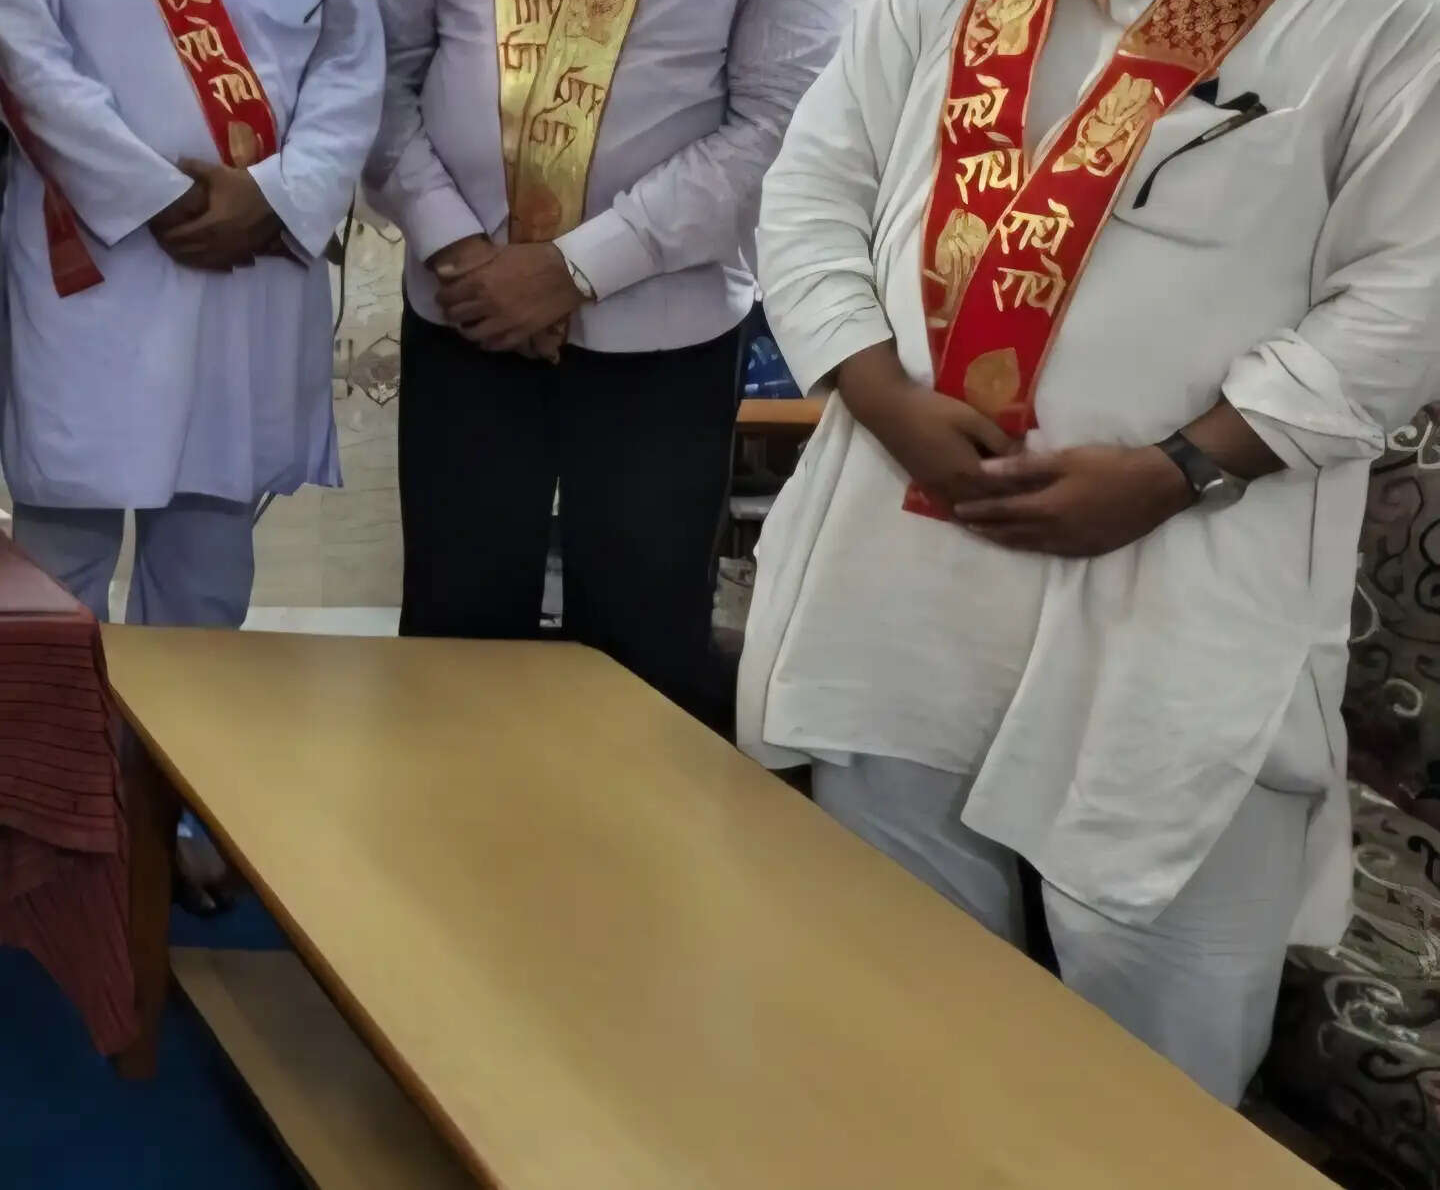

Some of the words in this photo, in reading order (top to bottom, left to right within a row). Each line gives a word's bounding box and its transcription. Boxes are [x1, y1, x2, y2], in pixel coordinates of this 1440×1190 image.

[177, 15, 228, 73] राधे
[944, 73, 1010, 145] राधे
[955, 131, 1024, 205] राधे
[999, 198, 1075, 255] राधे
[992, 253, 1066, 318] राधे
